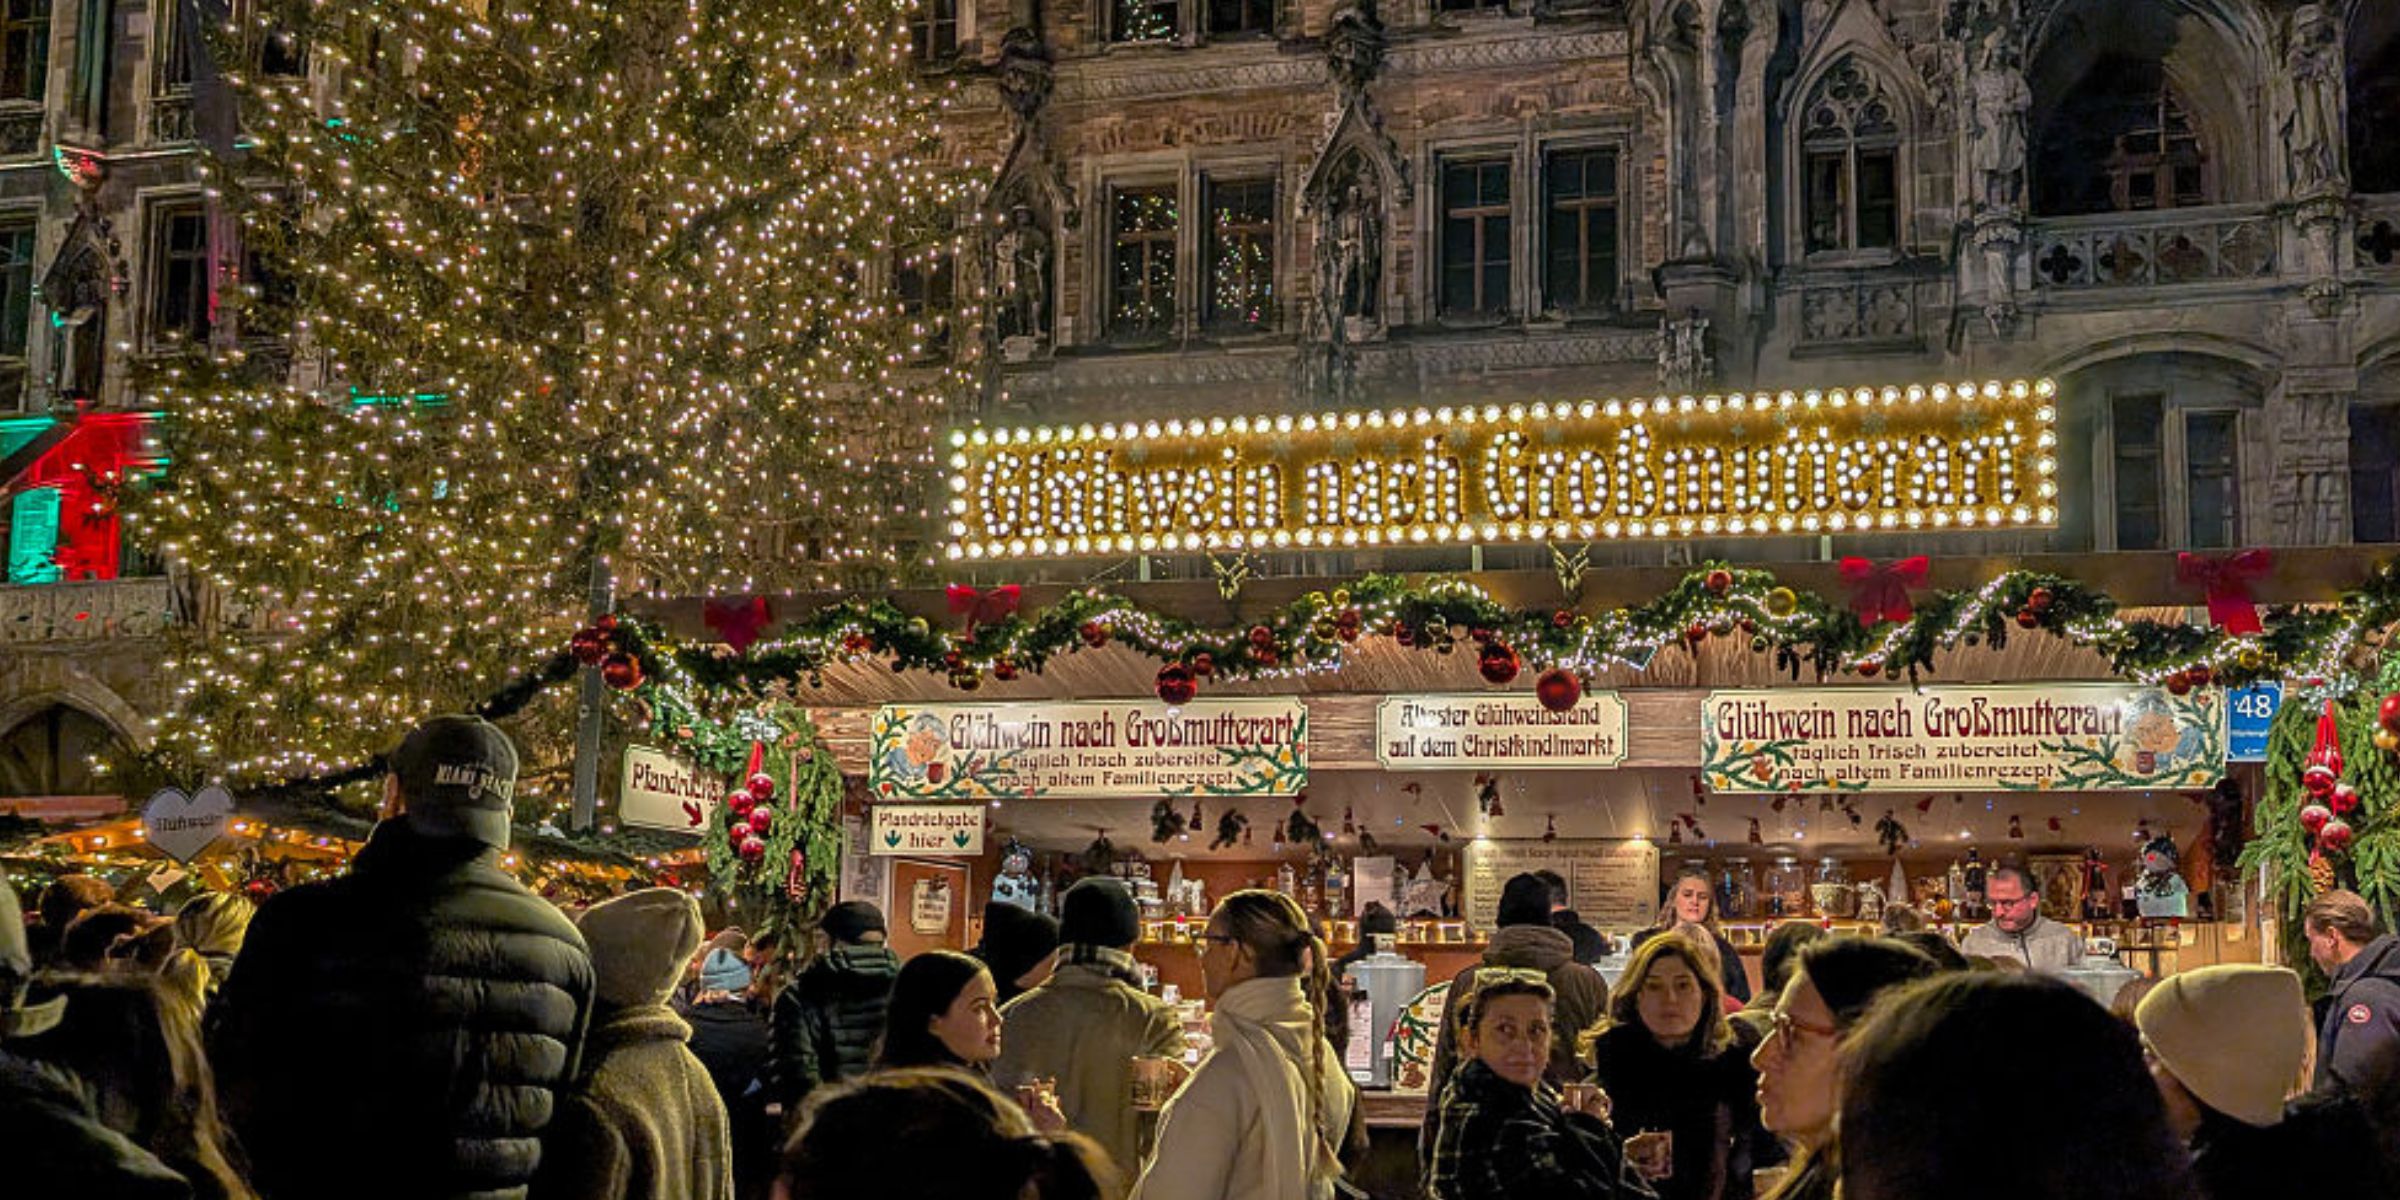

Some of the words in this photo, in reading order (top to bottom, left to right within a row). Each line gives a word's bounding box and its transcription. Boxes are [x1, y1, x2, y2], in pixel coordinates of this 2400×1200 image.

[979, 445, 1283, 538] Glühwein
[1304, 433, 1465, 527] nach
[1483, 418, 2024, 519] Großmutterart
[1474, 702, 1601, 726] Glühweinstand
[2237, 694, 2272, 718] 48
[950, 711, 1050, 749] Glühwein
[1060, 710, 1116, 748] nach
[1125, 709, 1294, 748] Großmutterart
[1717, 700, 1837, 741] Glühwein
[1847, 697, 1914, 738] nach
[1925, 696, 2122, 738] Großmutterart
[1388, 733, 1416, 757] auf
[1420, 735, 1458, 757] dem
[1462, 732, 1616, 757] Christkindlmarkt
[1792, 744, 1860, 762] täglich
[1867, 743, 1926, 760] frisch
[1011, 752, 1070, 770] täglich
[1077, 751, 1127, 768] frisch
[1778, 761, 1826, 780] nach
[1835, 763, 1892, 780] altem
[631, 762, 726, 806] Pfandrückg
[1000, 772, 1041, 788] nach
[1048, 771, 1095, 787] altem
[878, 810, 979, 830] Pfandrückgabe
[909, 832, 946, 848] hier
